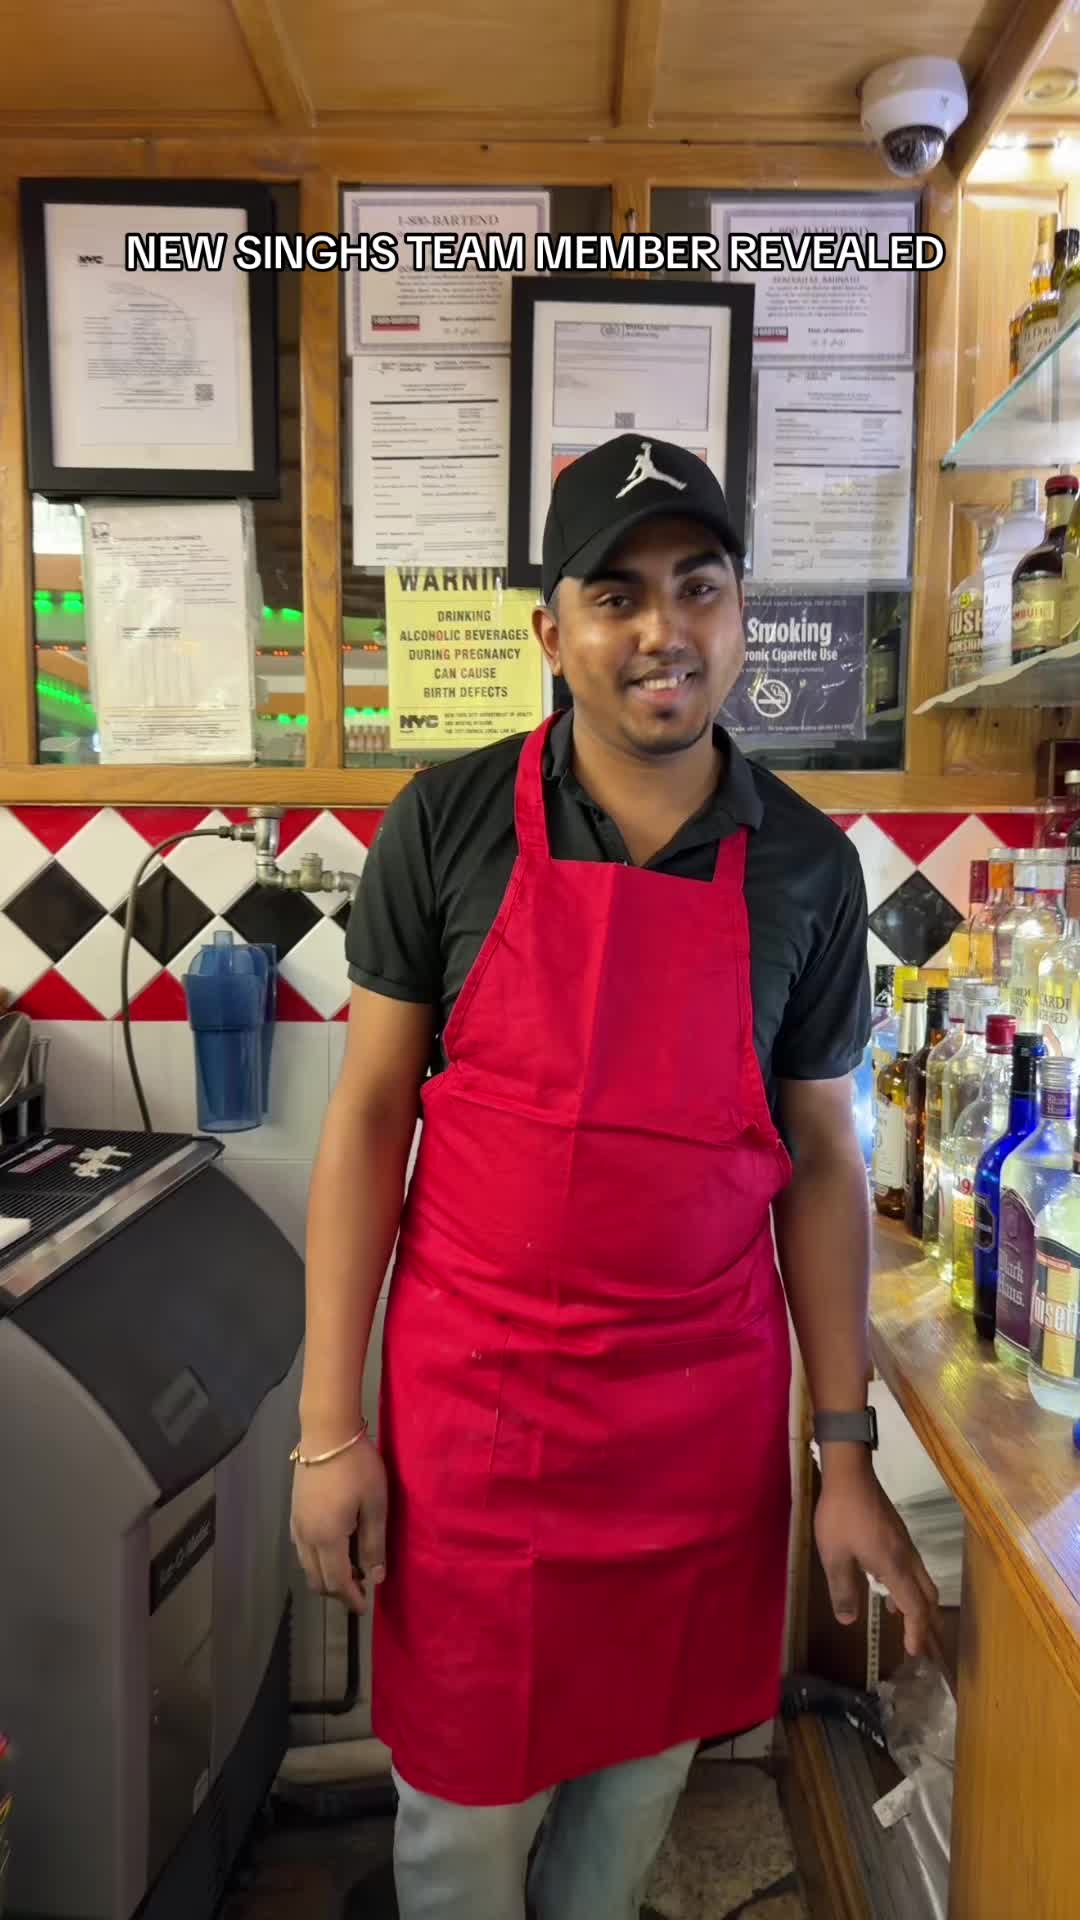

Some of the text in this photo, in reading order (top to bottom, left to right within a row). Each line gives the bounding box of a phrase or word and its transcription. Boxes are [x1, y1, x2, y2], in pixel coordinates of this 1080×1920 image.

[398, 567, 507, 592] WARNIN
[437, 610, 492, 623] DRINKING
[400, 628, 529, 642] ALCOHOLIC BEVERAGES
[747, 617, 832, 646] Smoking
[408, 648, 521, 661] DURING PREGNANCY
[745, 648, 838, 664] ronic Cigarette Use
[434, 667, 497, 680] CAN CAUSE
[423, 686, 508, 698] BIRTH DEFECTS
[400, 714, 439, 729] NYC
